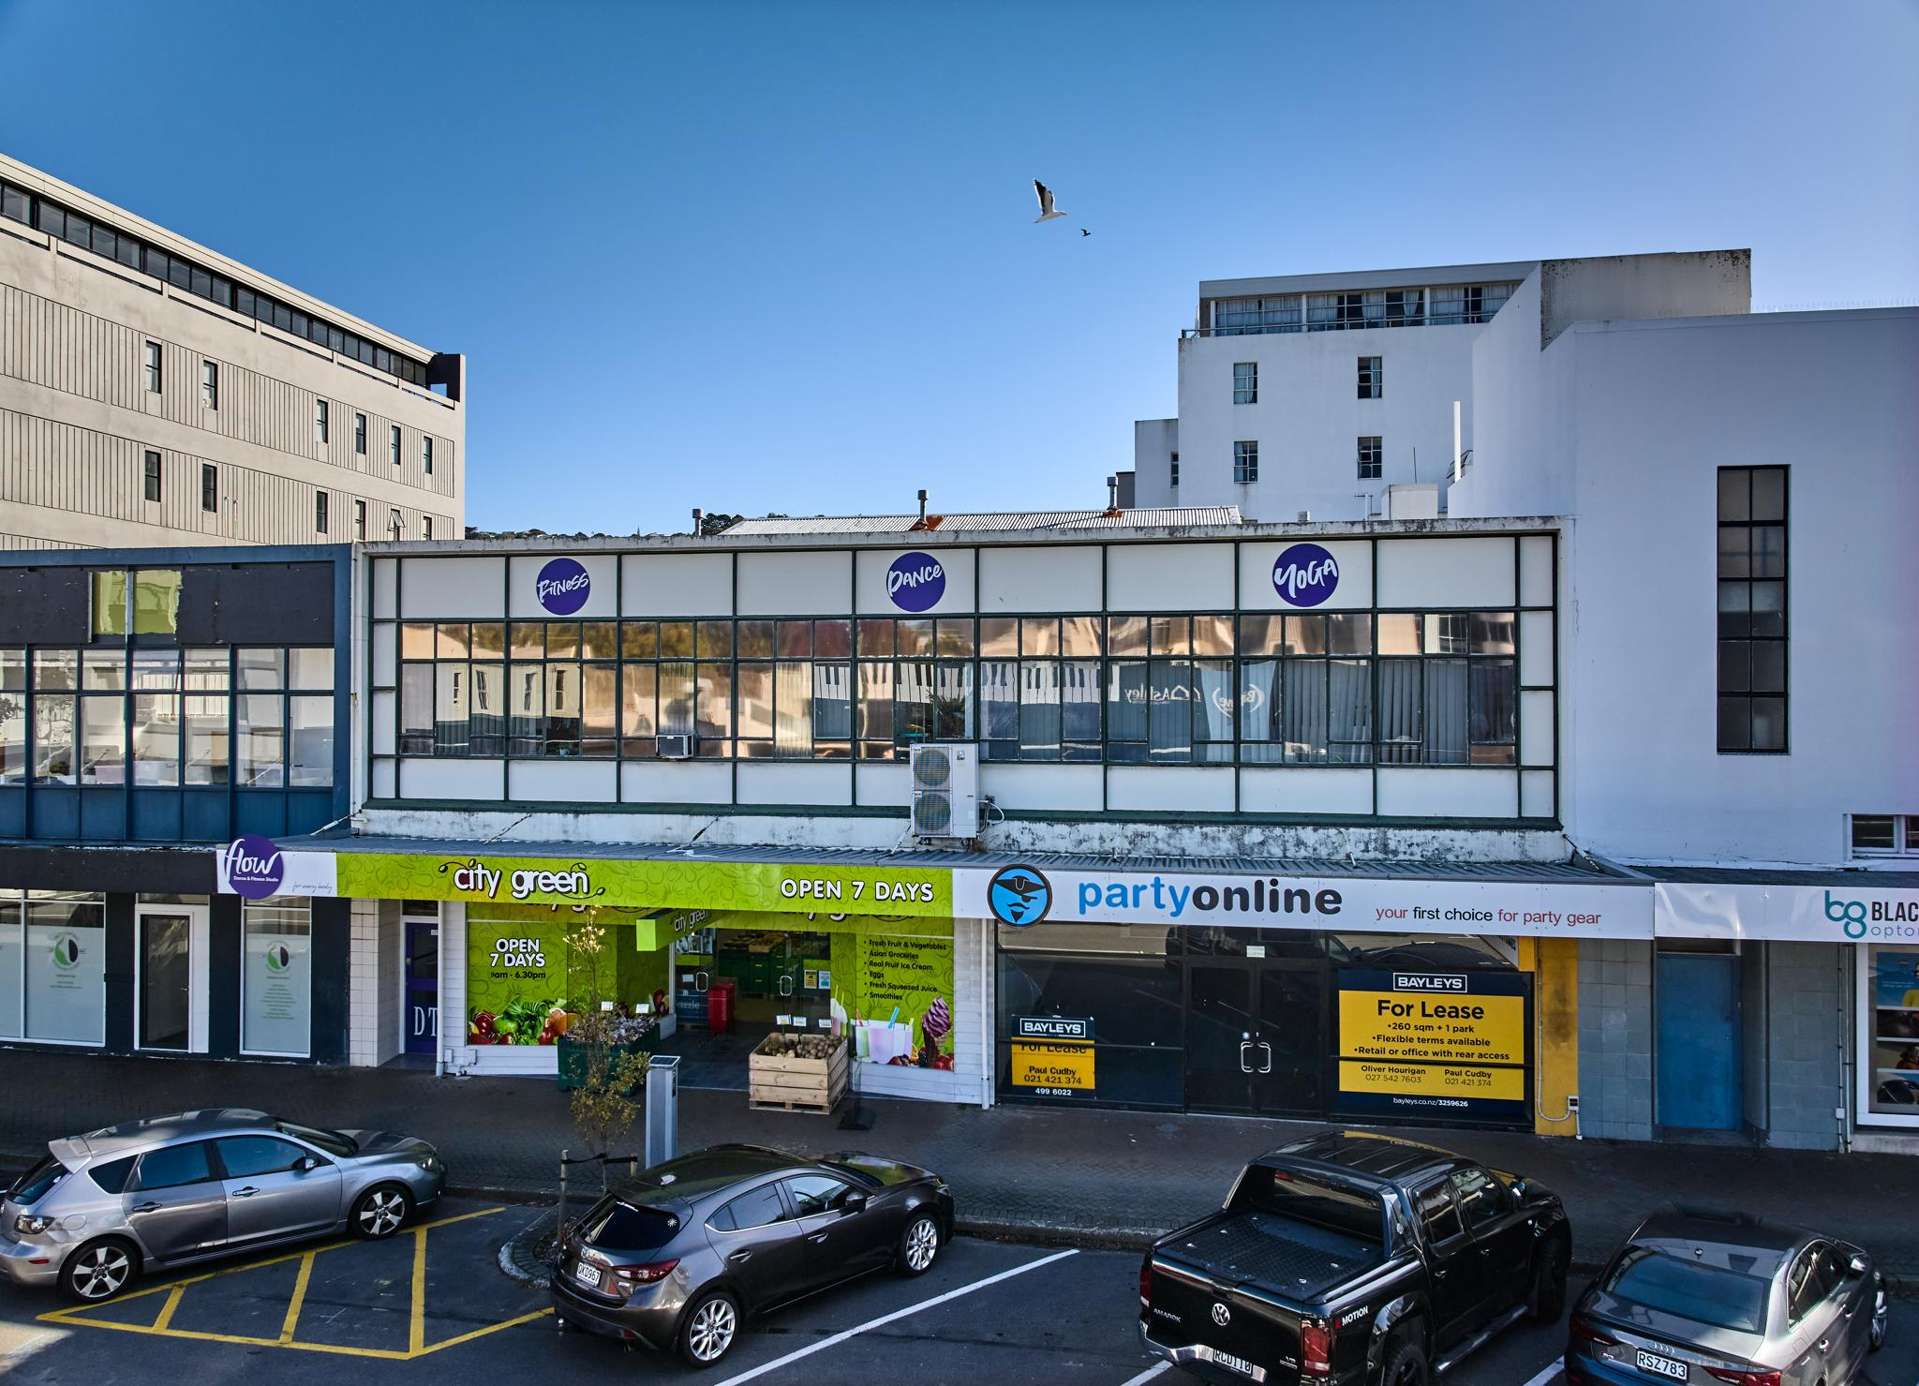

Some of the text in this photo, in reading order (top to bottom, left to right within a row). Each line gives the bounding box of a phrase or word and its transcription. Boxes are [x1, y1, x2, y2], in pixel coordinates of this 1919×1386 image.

[225, 838, 281, 883] flow
[454, 859, 590, 899] city green
[780, 878, 935, 903] OPEN 7 DAYS
[1078, 876, 1343, 918] partyonline
[1376, 906, 1602, 927] your first choice for party gear
[496, 938, 540, 953] OPEN
[490, 953, 546, 968] 7 DAYS
[884, 960, 899, 968] Fruit
[900, 961, 910, 969] Ice
[869, 970, 884, 979] Eggs
[1397, 976, 1463, 989] BAYLEYS
[1378, 999, 1485, 1020] For Lease
[1023, 1022, 1081, 1034] BAYLEYS
[1413, 1024, 1434, 1033] sqm
[1446, 1024, 1450, 1033] 1
[1452, 1024, 1475, 1034] park
[1417, 1036, 1444, 1045] terms
[1447, 1037, 1491, 1047] available
[1388, 1048, 1398, 1056] or
[1401, 1047, 1429, 1057] office
[1432, 1049, 1453, 1058] with
[1455, 1051, 1475, 1060] rear
[1477, 1052, 1510, 1060] access
[1029, 1065, 1077, 1077] Paul Cudby
[1361, 1065, 1426, 1076] Oliver Hourigan
[1444, 1069, 1492, 1080] Paul Cudby
[1023, 1074, 1082, 1085] 021 421 374
[1365, 1073, 1422, 1083] 027 542 7603
[1445, 1077, 1492, 1087] 021 421 374
[1035, 1087, 1050, 1095] 499
[1638, 1352, 1686, 1378] RSZ783
